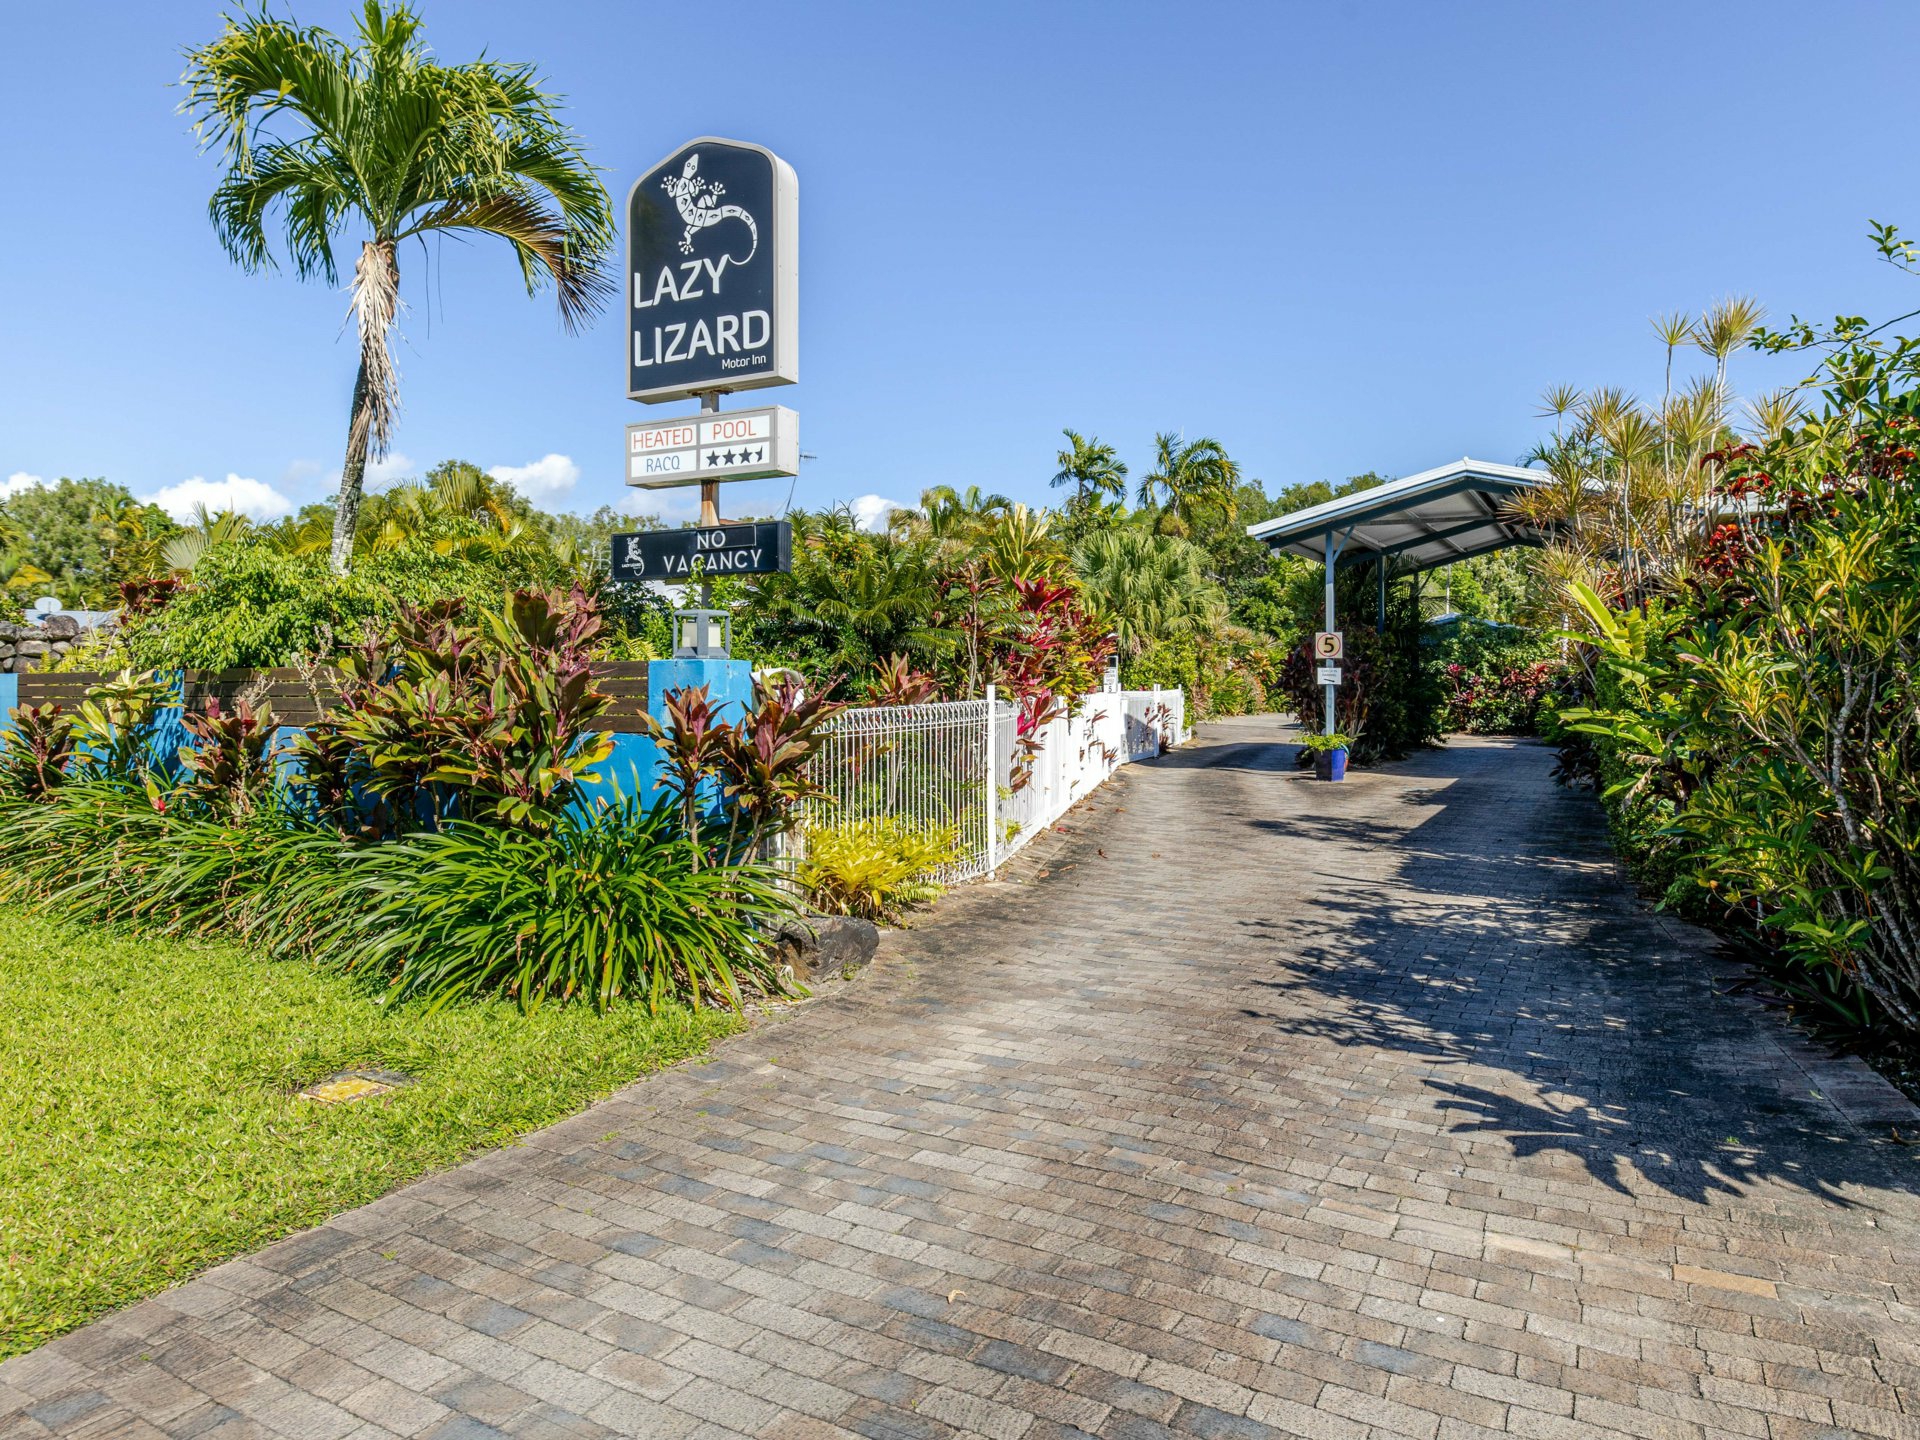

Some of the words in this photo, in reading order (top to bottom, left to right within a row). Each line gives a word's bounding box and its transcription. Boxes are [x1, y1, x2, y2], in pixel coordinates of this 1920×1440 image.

[634, 254, 729, 308] LAZY
[634, 309, 771, 367] LIZARD
[721, 357, 751, 370] Motor
[752, 354, 767, 365] Inn
[633, 427, 693, 449] HEATED
[712, 419, 757, 441] POOL
[646, 455, 680, 472] RACQ
[697, 530, 726, 549] NO
[663, 549, 762, 573] VACANCY
[1323, 637, 1335, 653] 5
